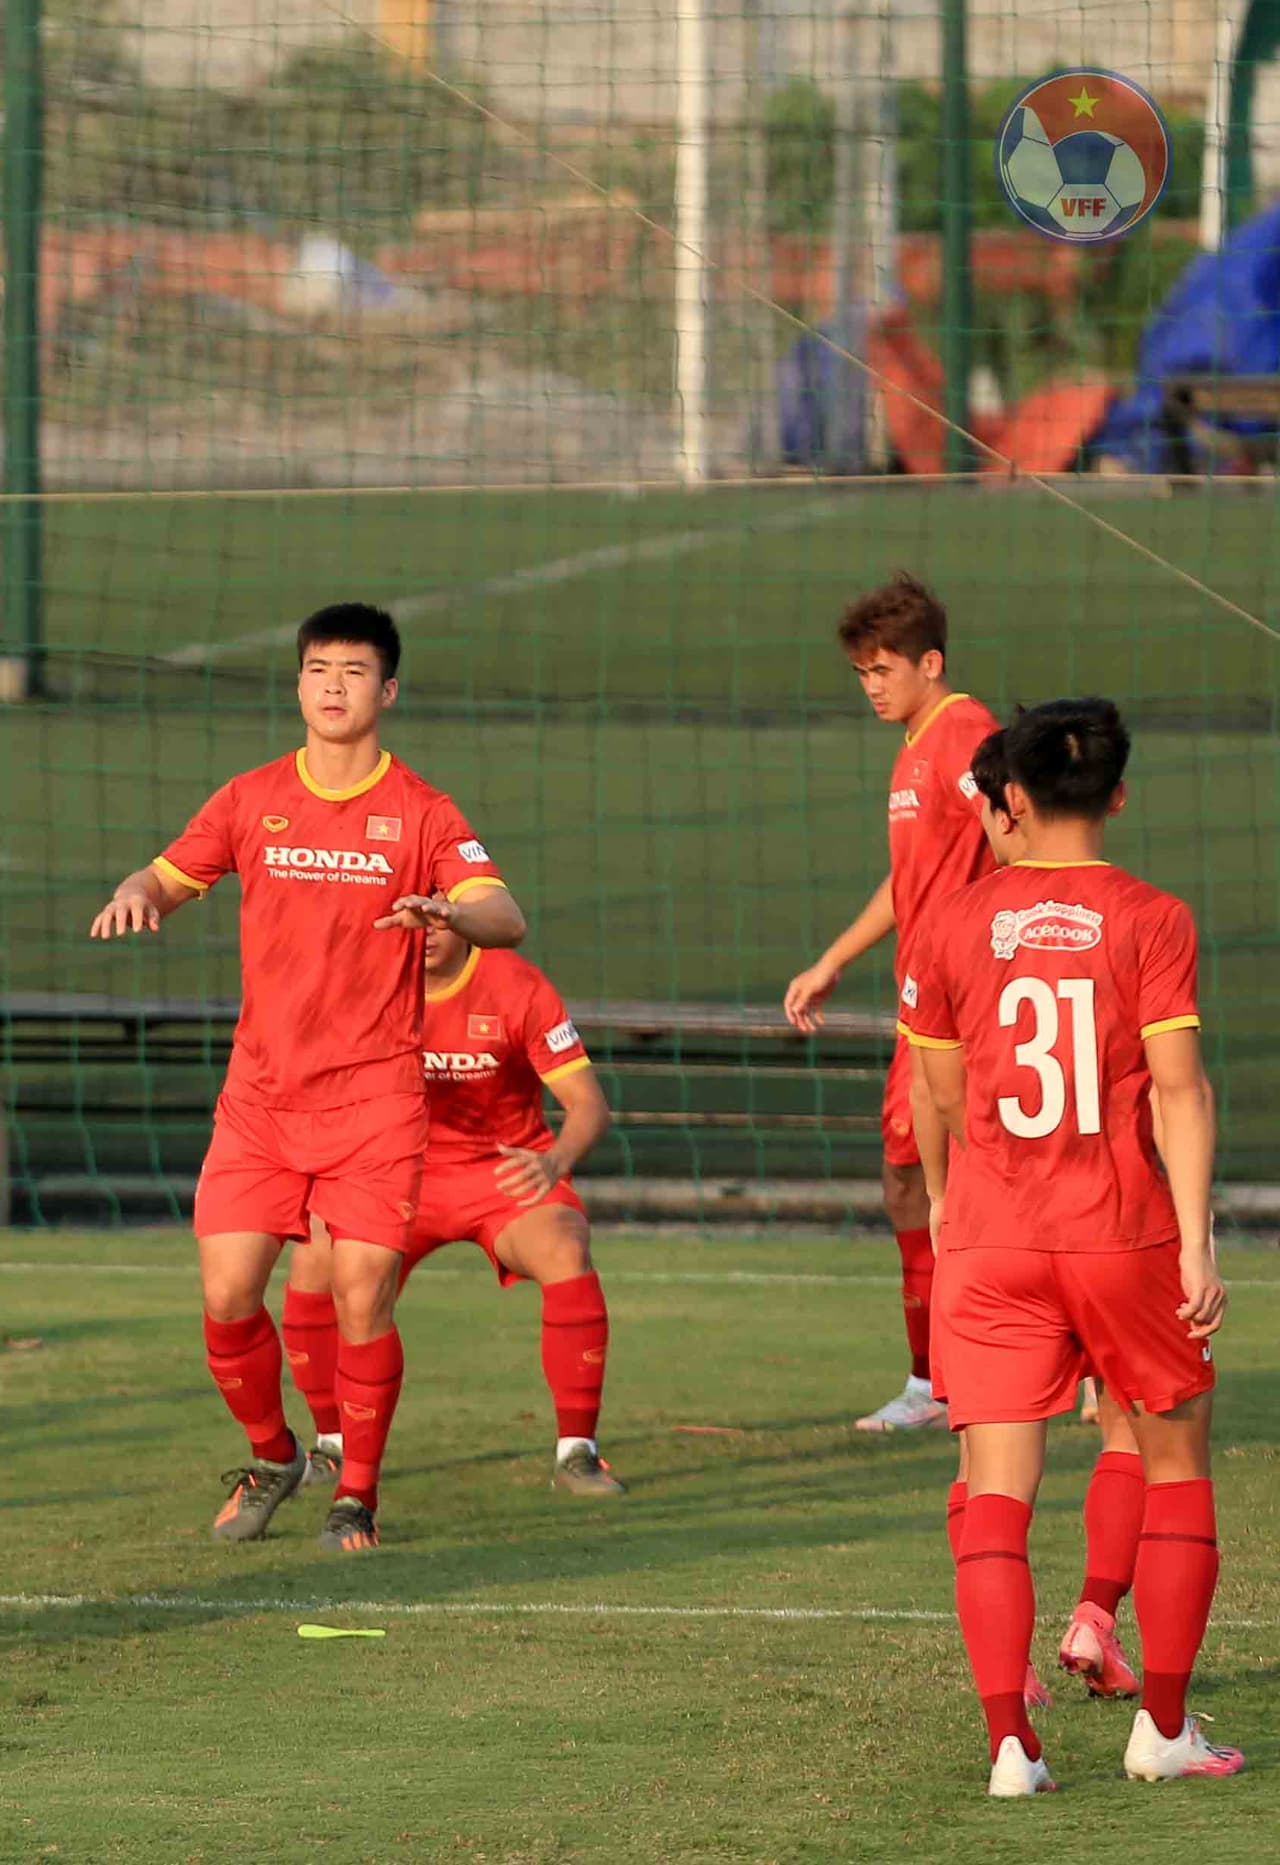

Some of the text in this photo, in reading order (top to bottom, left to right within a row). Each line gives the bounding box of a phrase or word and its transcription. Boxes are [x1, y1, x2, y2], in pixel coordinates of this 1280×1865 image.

[263, 846, 393, 873] HONDA
[268, 868, 386, 885] The Power of Dreams
[422, 1052, 499, 1070] NDA
[998, 976, 1101, 1139] 31
